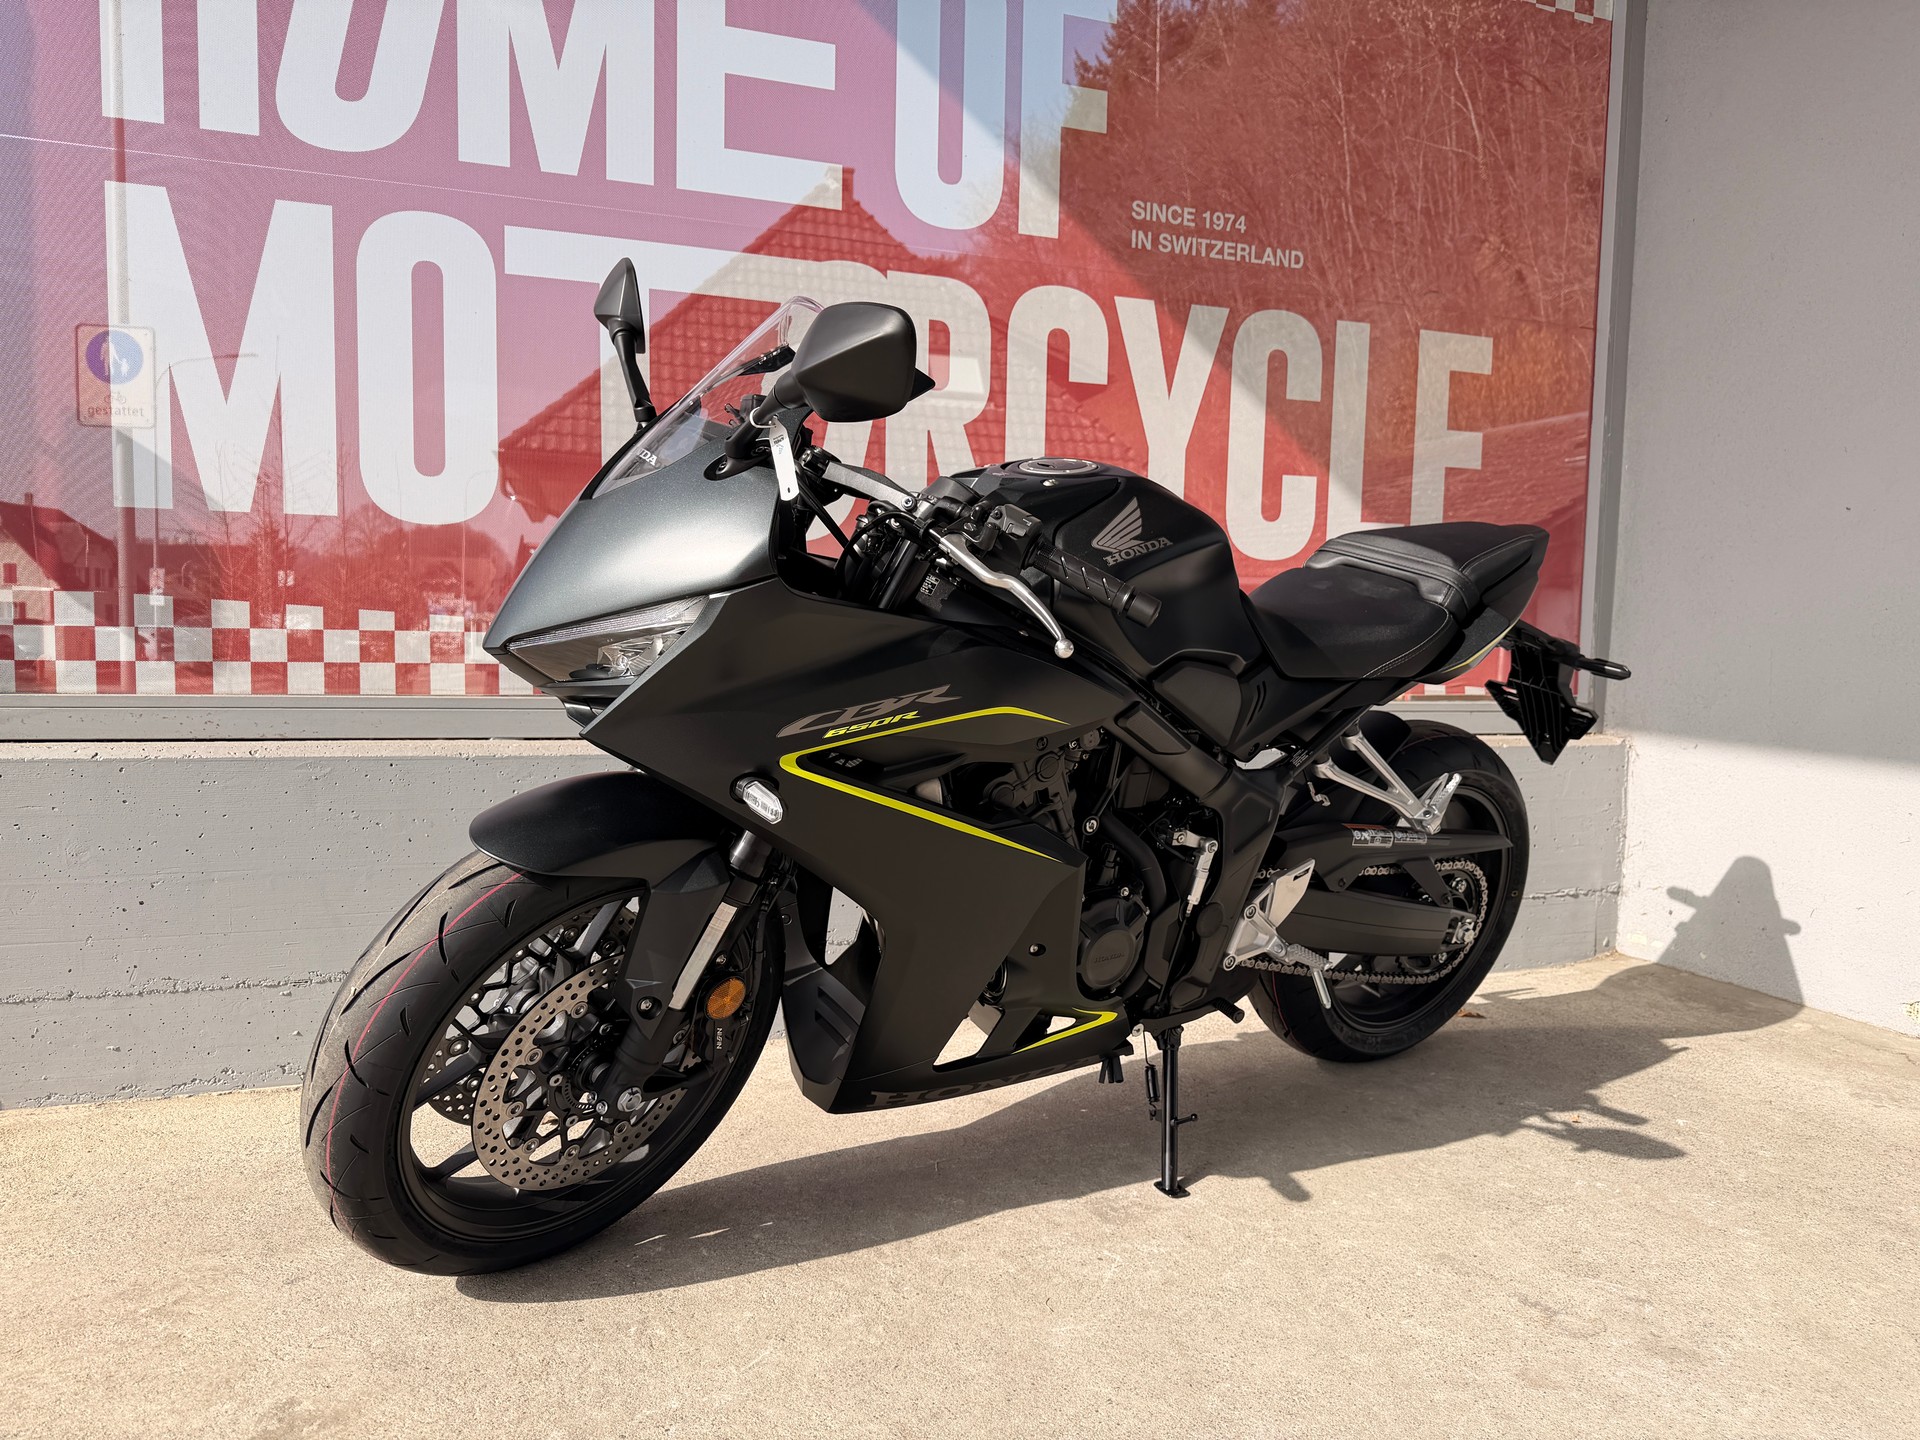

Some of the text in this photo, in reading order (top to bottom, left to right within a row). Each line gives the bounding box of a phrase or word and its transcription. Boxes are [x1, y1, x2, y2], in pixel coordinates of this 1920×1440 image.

[895, 0, 1118, 239] OF
[1131, 200, 1247, 234] SINCE 1974
[1131, 229, 1305, 269] IN SWITZERLAND
[87, 406, 145, 418] gestattet
[1103, 536, 1173, 567] HONDA
[776, 684, 962, 738] CBR
[822, 710, 921, 739] 650R
